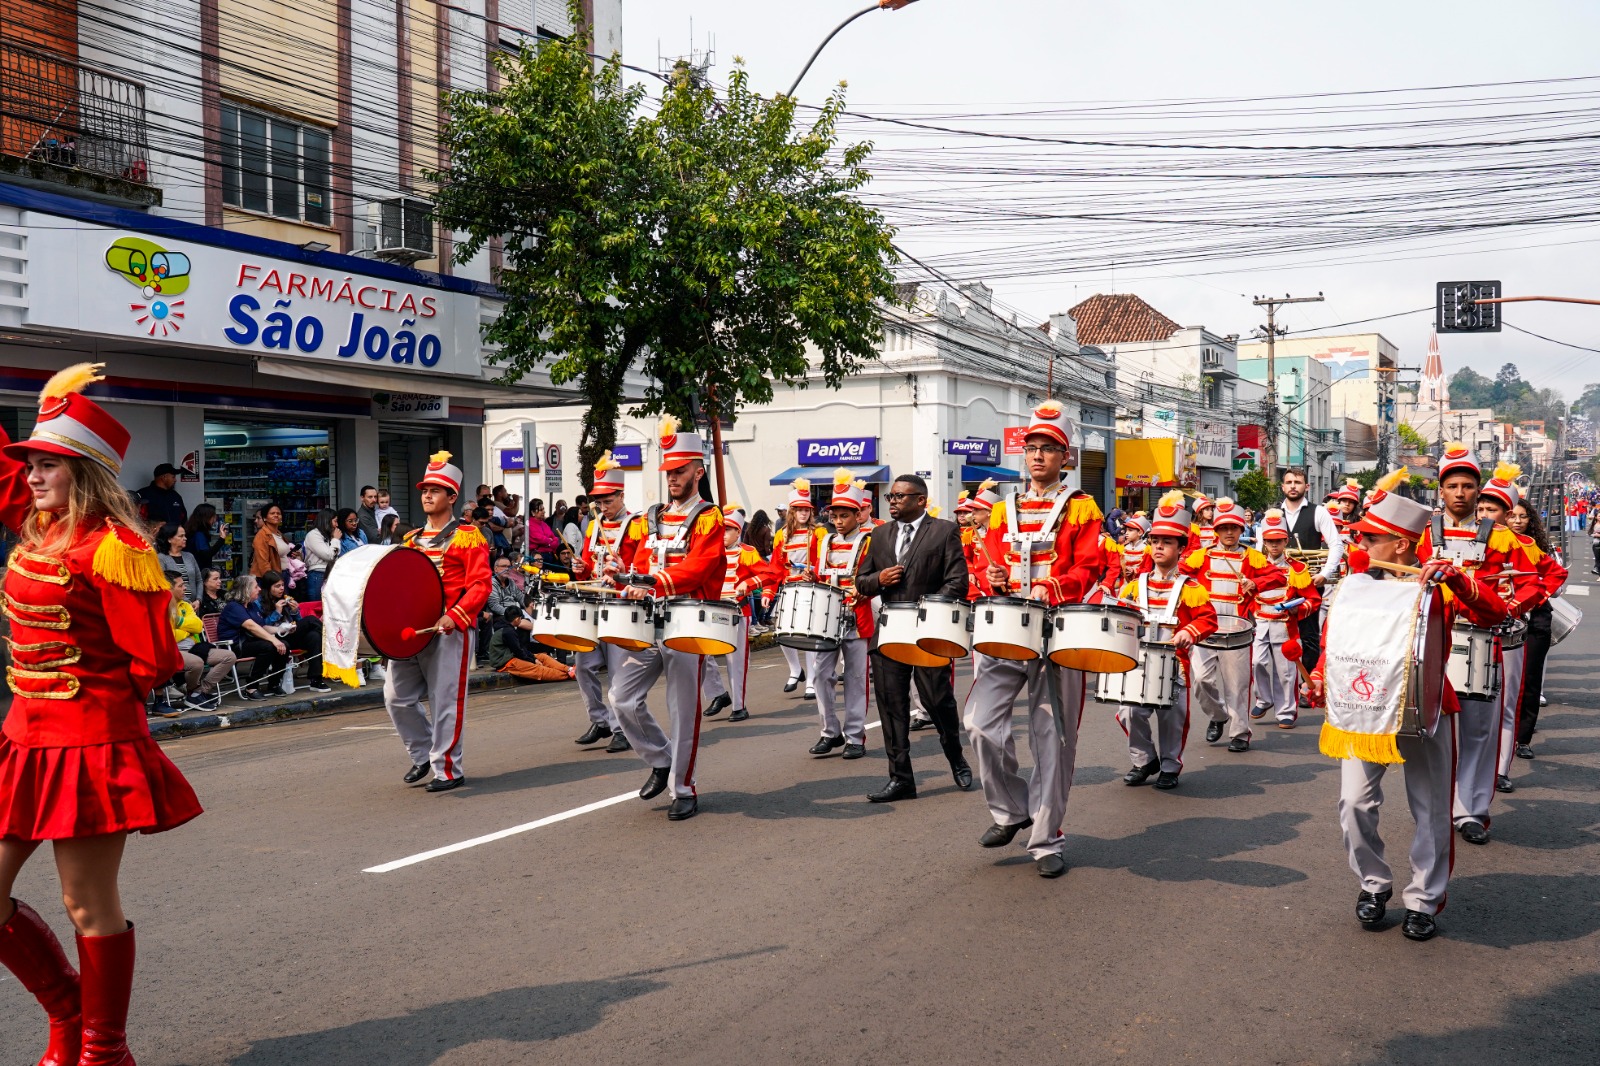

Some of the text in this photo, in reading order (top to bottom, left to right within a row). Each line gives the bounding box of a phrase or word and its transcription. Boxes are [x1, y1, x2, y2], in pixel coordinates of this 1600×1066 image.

[236, 263, 437, 318] FARMÁCIAS
[222, 293, 441, 368] São João
[390, 400, 441, 412] São João
[806, 441, 866, 457] PanVel
[952, 441, 984, 451] PanVel
[1209, 438, 1226, 458] João
[550, 448, 558, 465] E
